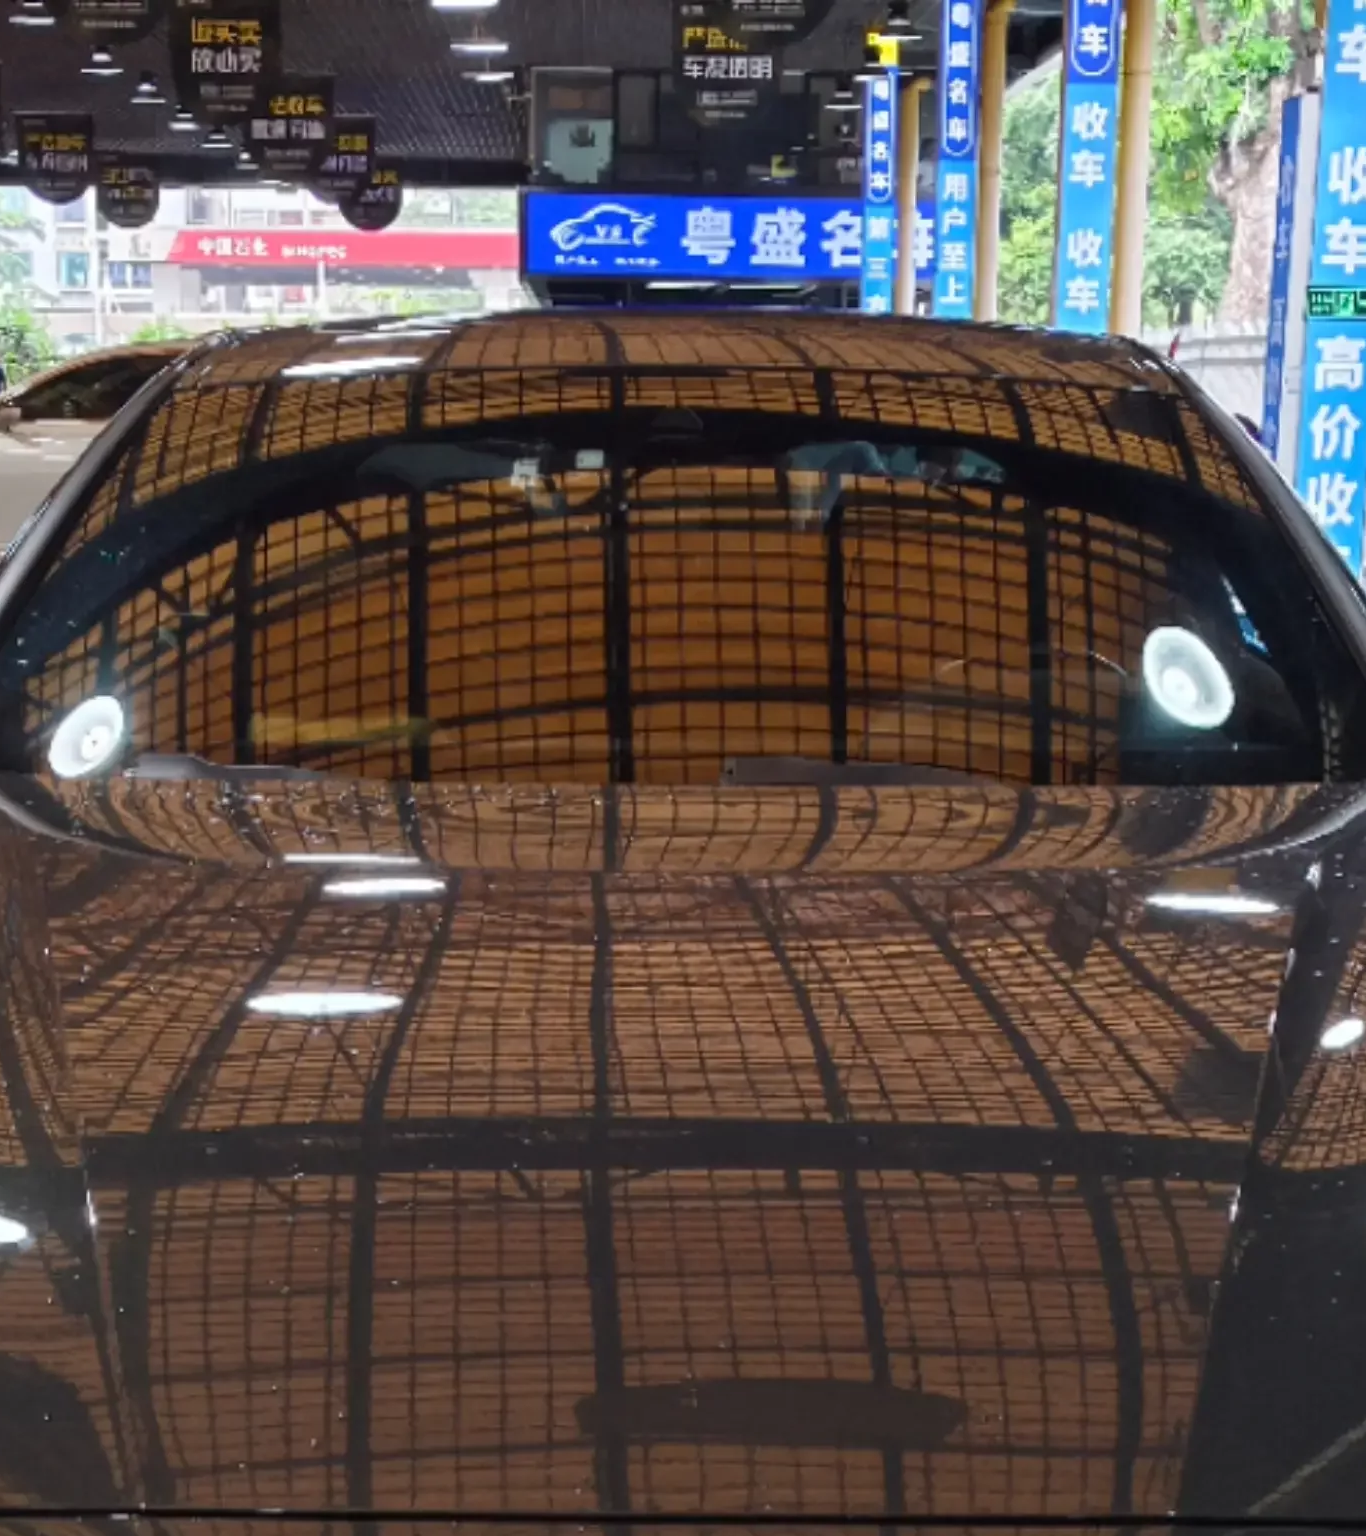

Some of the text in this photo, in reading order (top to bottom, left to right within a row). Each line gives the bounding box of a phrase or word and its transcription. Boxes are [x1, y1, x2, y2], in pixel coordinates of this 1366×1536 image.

[197, 236, 270, 258] 中国石化
[938, 172, 970, 304] 用户至上
[1064, 102, 1109, 316] 收车 收车
[1304, 334, 1366, 558] 高价收
